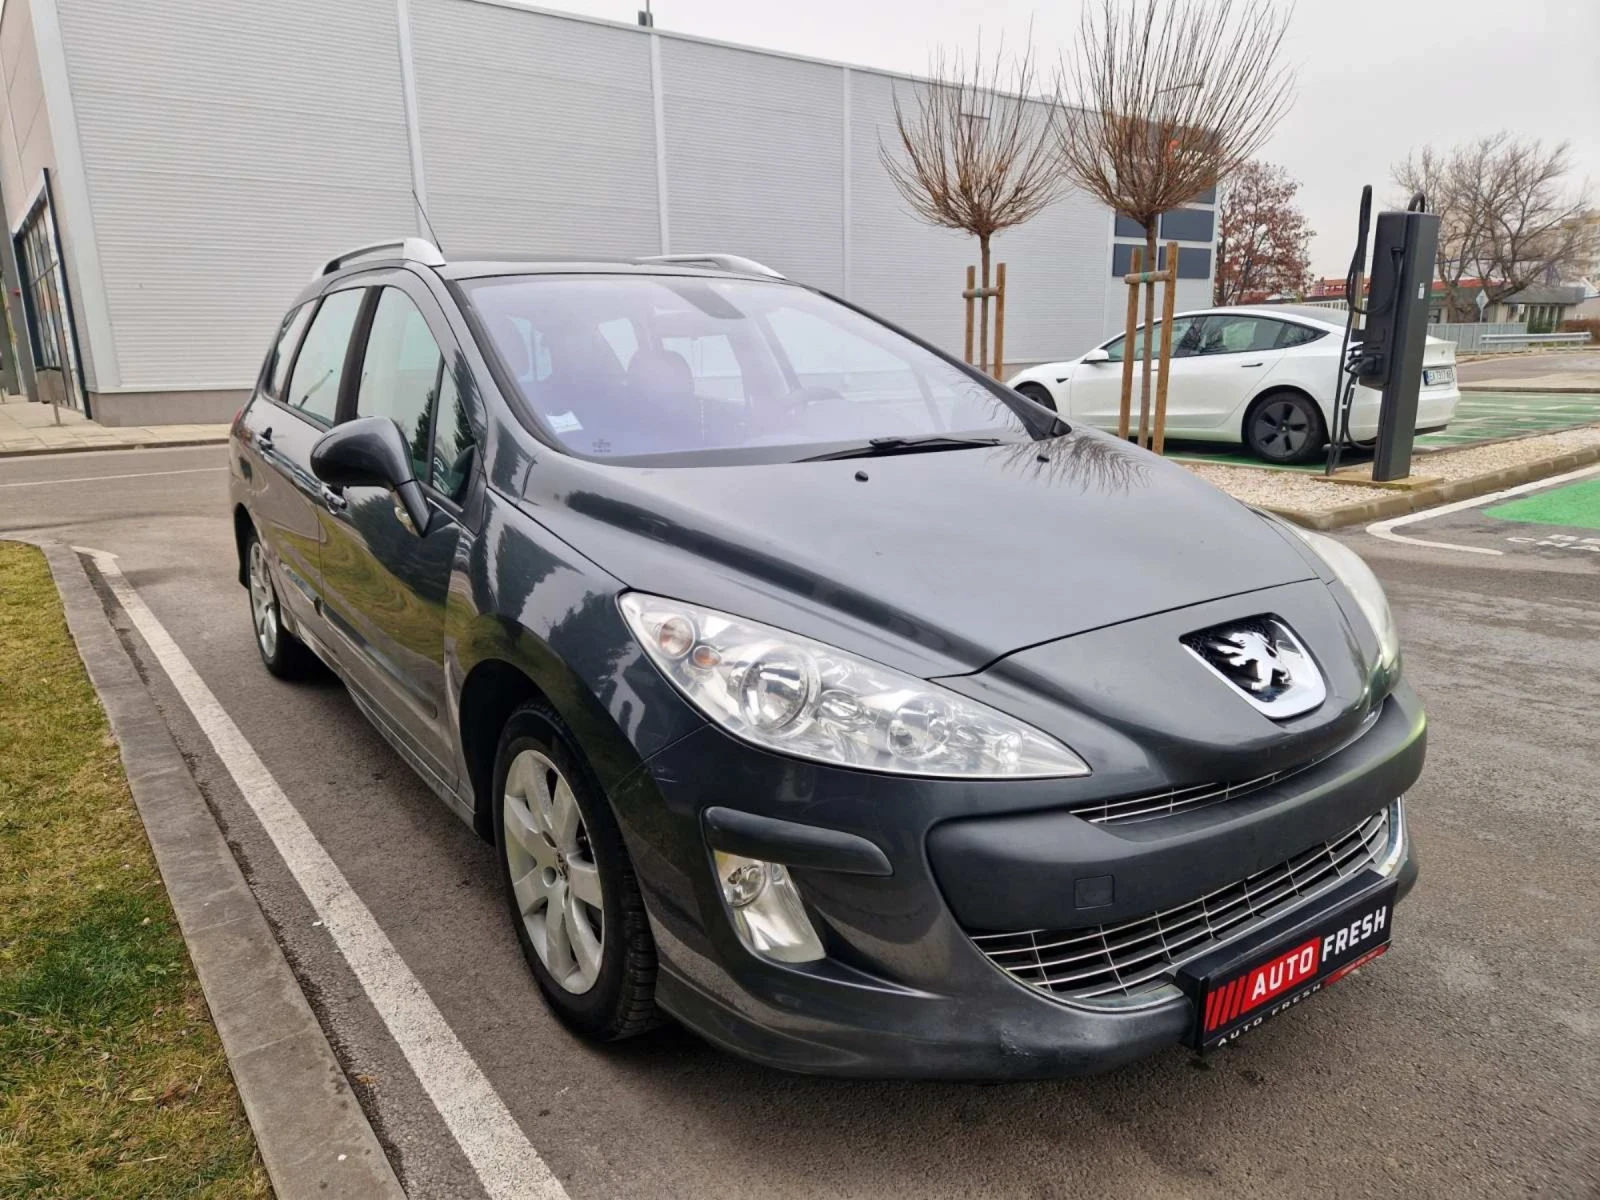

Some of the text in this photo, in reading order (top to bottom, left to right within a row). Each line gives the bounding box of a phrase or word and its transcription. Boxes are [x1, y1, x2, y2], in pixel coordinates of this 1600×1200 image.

[1251, 945, 1314, 1001] AUTO
[1322, 905, 1387, 962] FRESH
[1218, 983, 1321, 1047] AUTO FRESH
